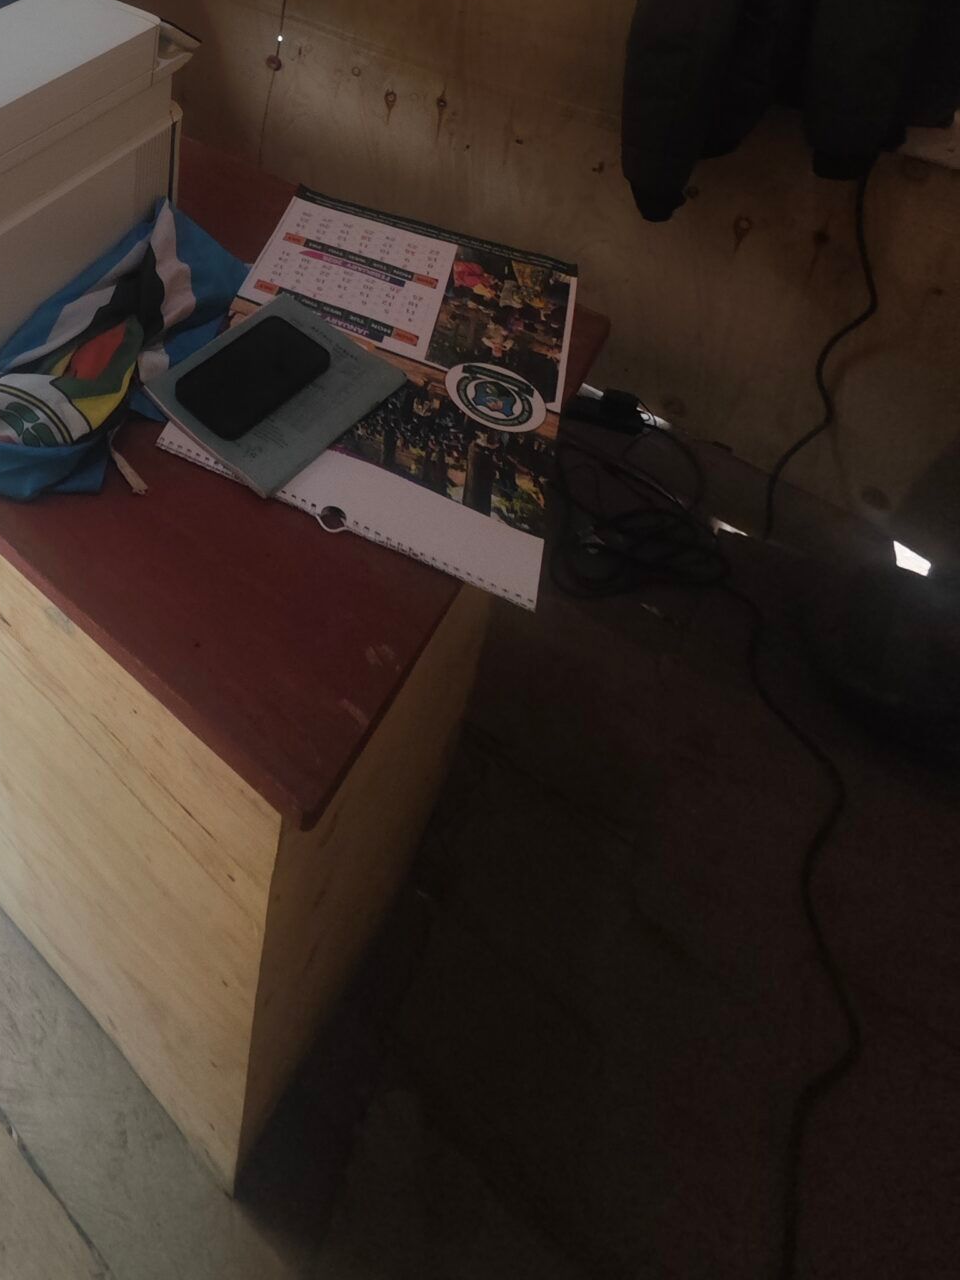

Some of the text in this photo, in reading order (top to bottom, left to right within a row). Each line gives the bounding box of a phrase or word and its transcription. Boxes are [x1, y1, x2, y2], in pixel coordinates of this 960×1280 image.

[345, 262, 391, 280] FEBRUARY
[323, 315, 369, 336] JANUARY
[369, 322, 391, 334] MON
